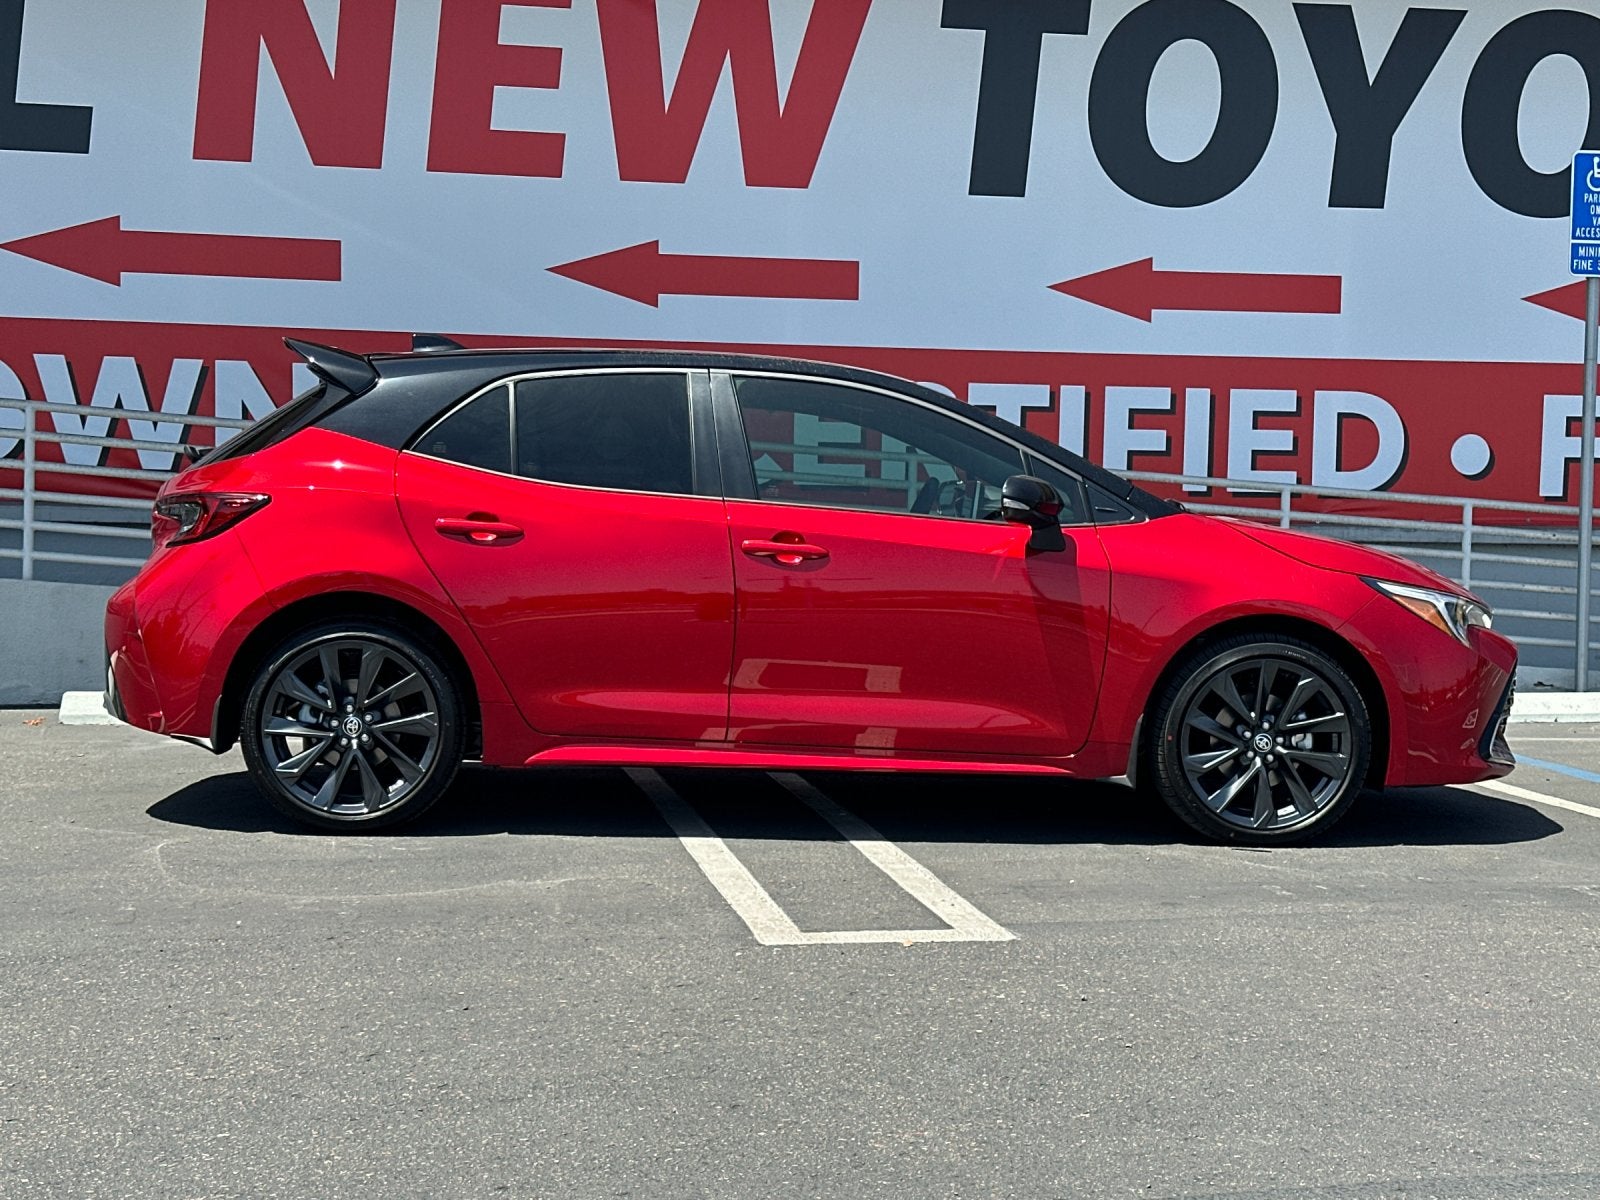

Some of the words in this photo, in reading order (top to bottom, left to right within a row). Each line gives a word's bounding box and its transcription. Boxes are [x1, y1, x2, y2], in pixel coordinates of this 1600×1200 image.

[193, 0, 875, 188] NEW
[942, 0, 1600, 218] TOYO
[1573, 259, 1593, 271] FINE
